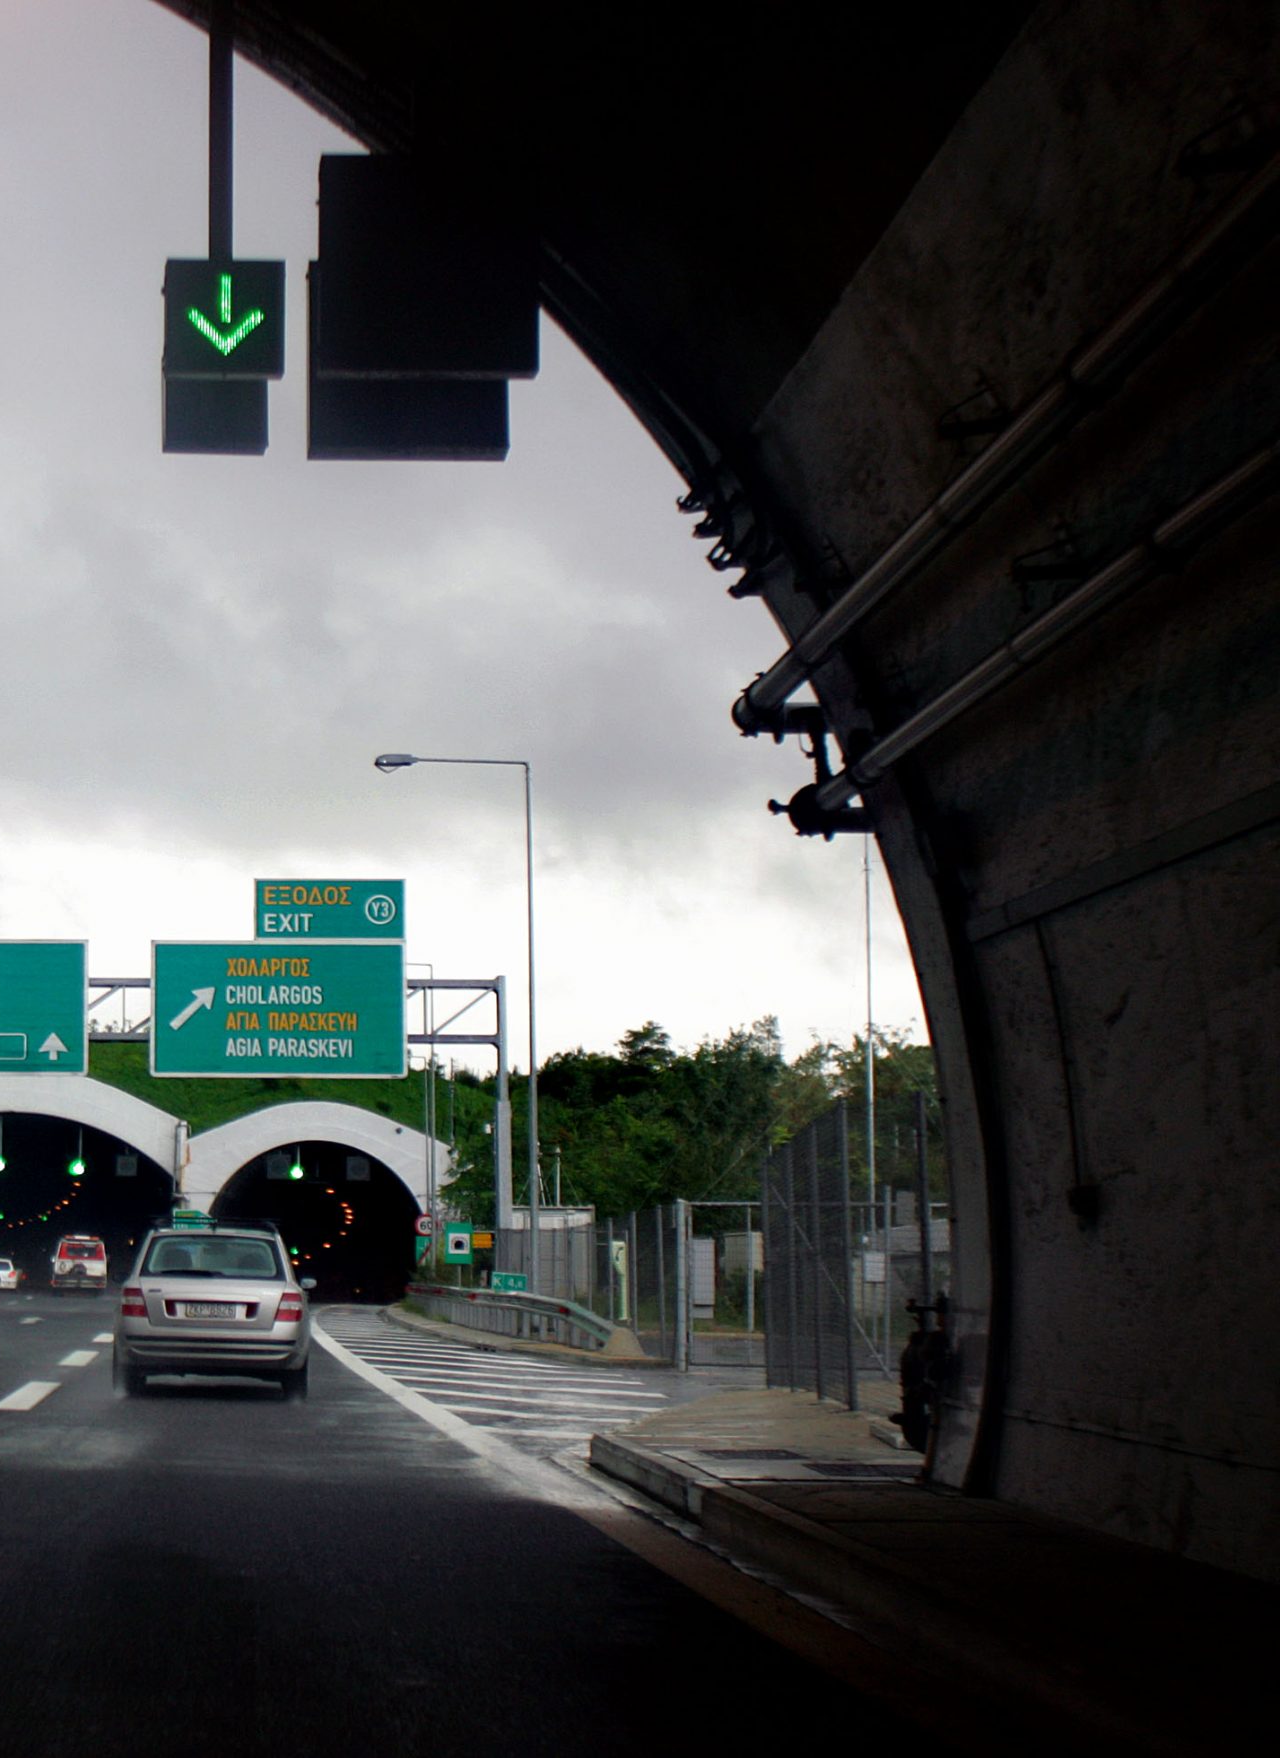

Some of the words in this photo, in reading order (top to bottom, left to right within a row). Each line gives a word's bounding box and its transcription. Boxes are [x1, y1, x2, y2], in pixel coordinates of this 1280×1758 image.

[263, 885, 352, 906] ΕΞΟΔΟΣ
[371, 901, 390, 918] Y3
[263, 912, 314, 933] EXIT
[226, 957, 311, 977] ΧΟΛΑΡΓΟΣ
[225, 984, 323, 1006] CHOLARGOS
[225, 1011, 261, 1031] ΑΓΙΑ
[267, 1011, 358, 1032] ΠΑΡΑΣΚΕΥΗ
[225, 1037, 263, 1058] AGIA
[267, 1037, 354, 1059] PARASKEVI
